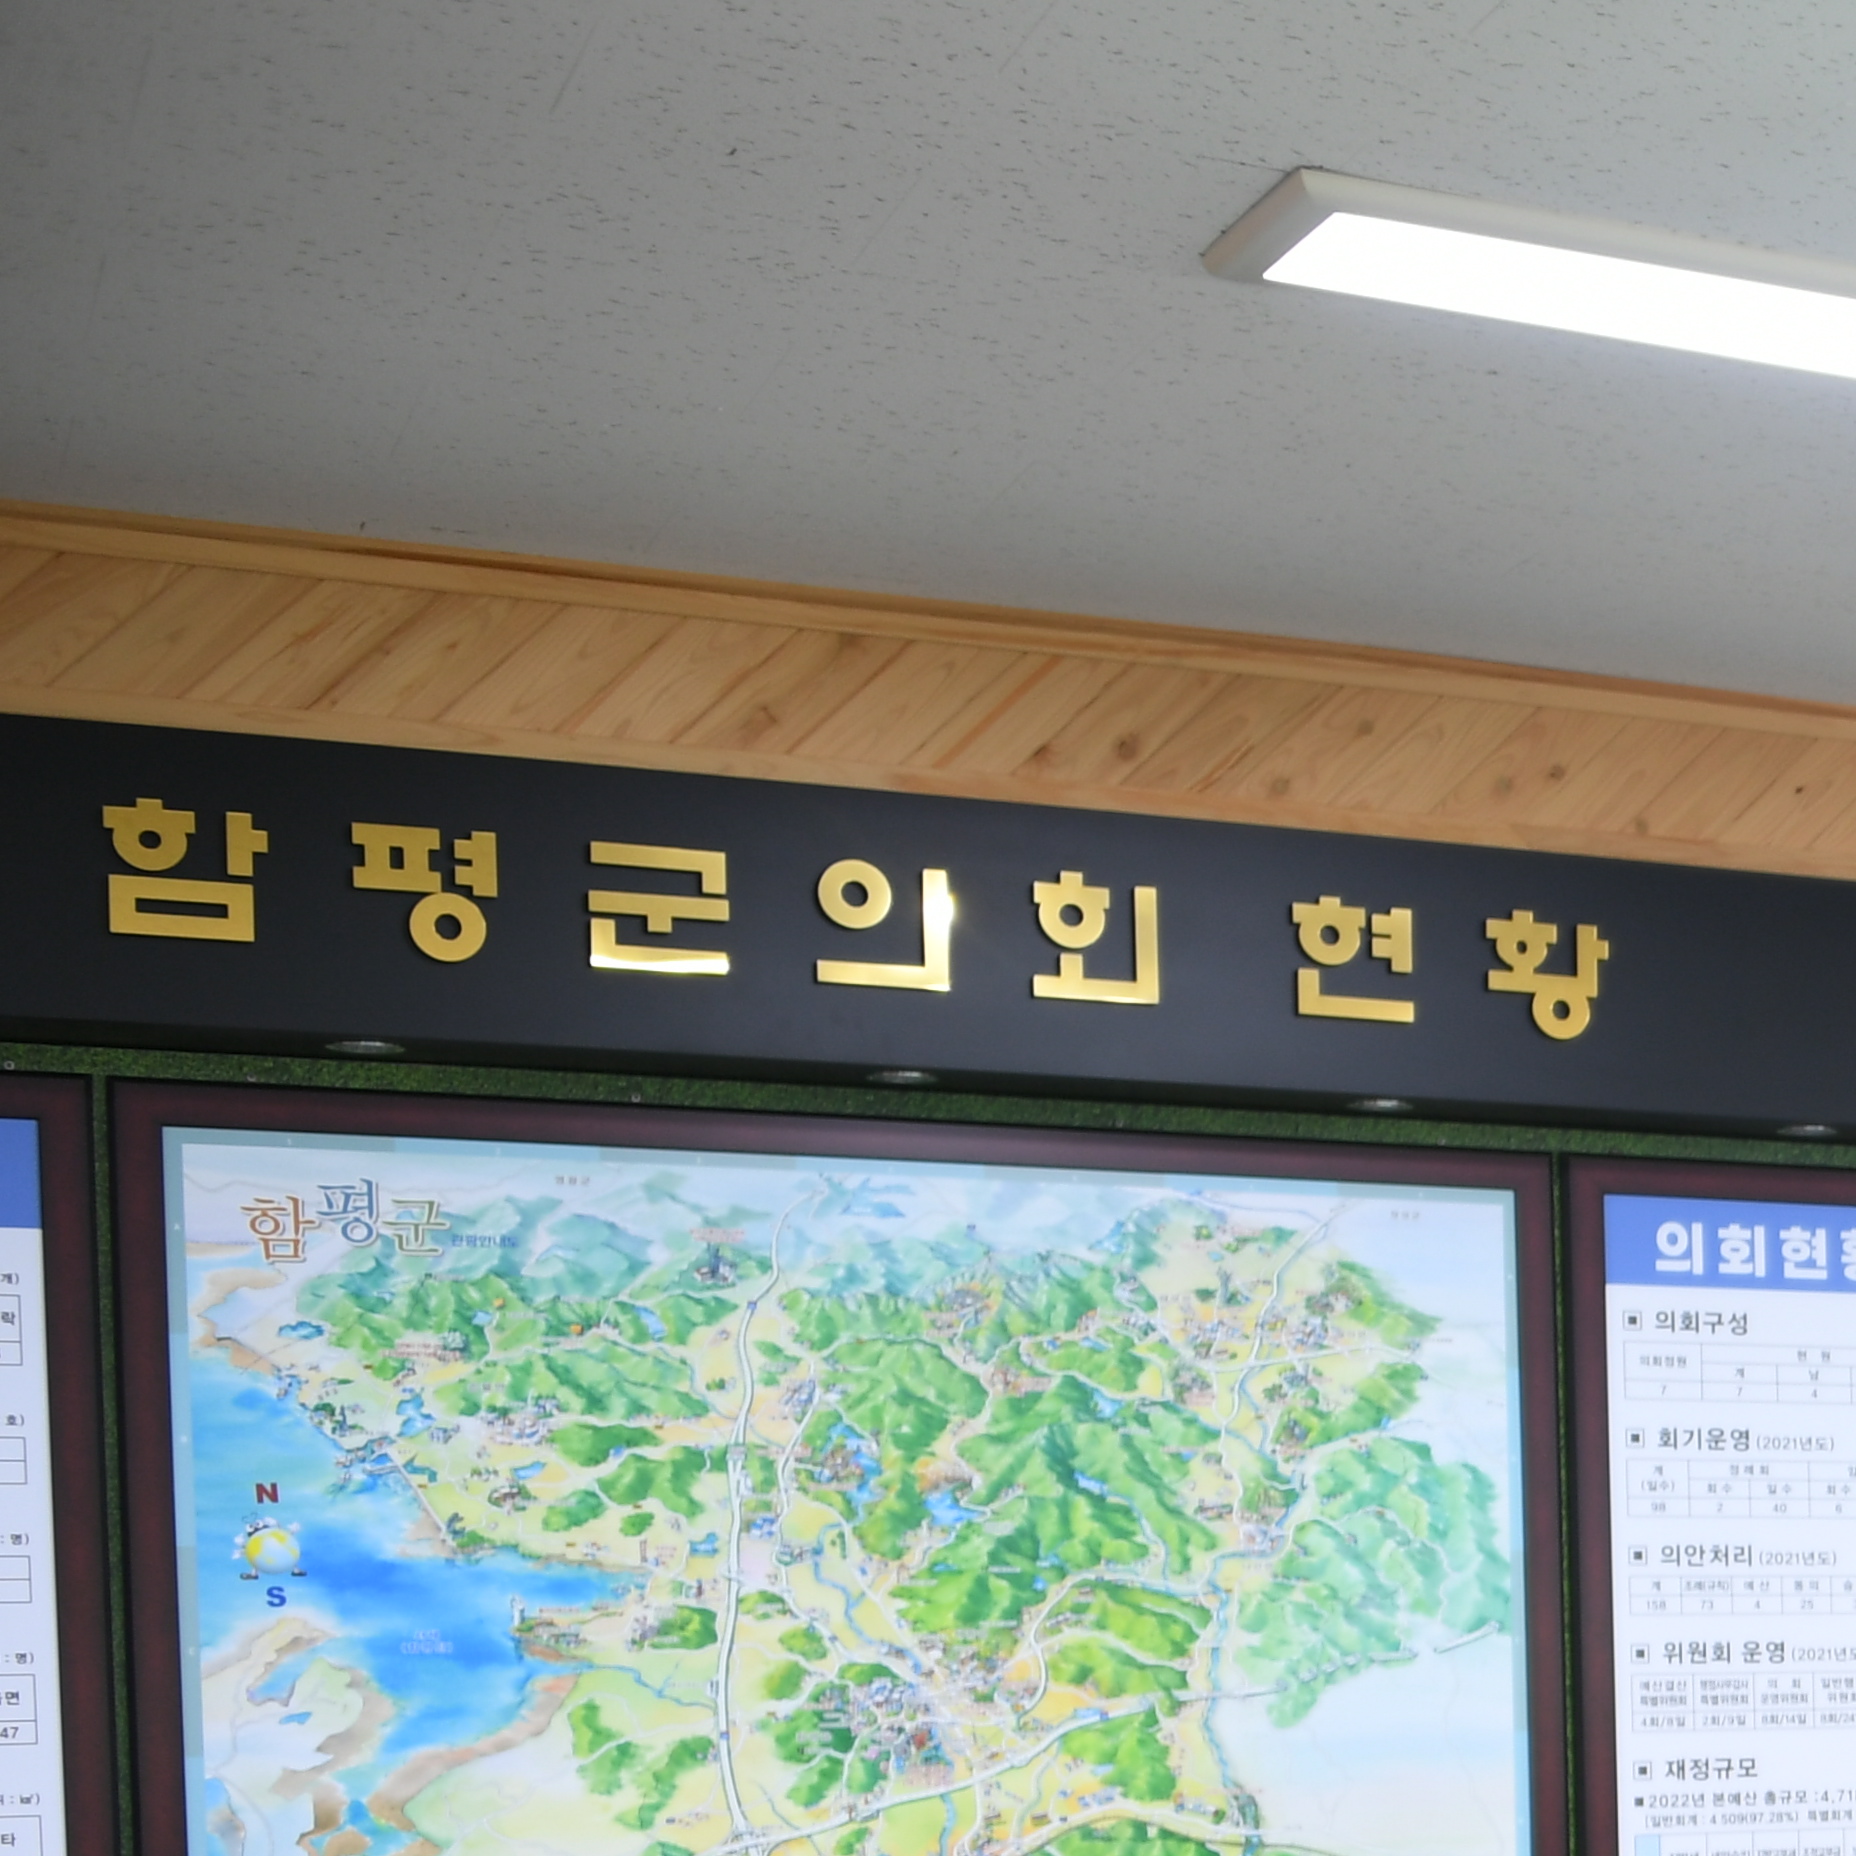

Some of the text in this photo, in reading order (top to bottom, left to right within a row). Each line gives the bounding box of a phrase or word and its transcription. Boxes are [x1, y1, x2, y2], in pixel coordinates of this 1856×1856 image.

[102, 796, 1610, 1041] 함평군의회 현황
[241, 1178, 451, 1263] 함평군
[1655, 1310, 1748, 1336] 의회구성
[1658, 1428, 1834, 1452] 회기운영 (2021년도)
[255, 1482, 279, 1503] N
[1660, 1544, 1837, 1567] 의안처리 (2021년도)
[266, 1587, 286, 1607] S
[1663, 1641, 1731, 1664] 위원회
[1741, 1641, 1786, 1663] 운영
[0, 1690, 21, 1706] 면
[1665, 1758, 1758, 1781] 재정규모
[1648, 1793, 1705, 1808] 2022년
[1712, 1791, 1757, 1806] 본예산
[1765, 1790, 1807, 1805] 총규모
